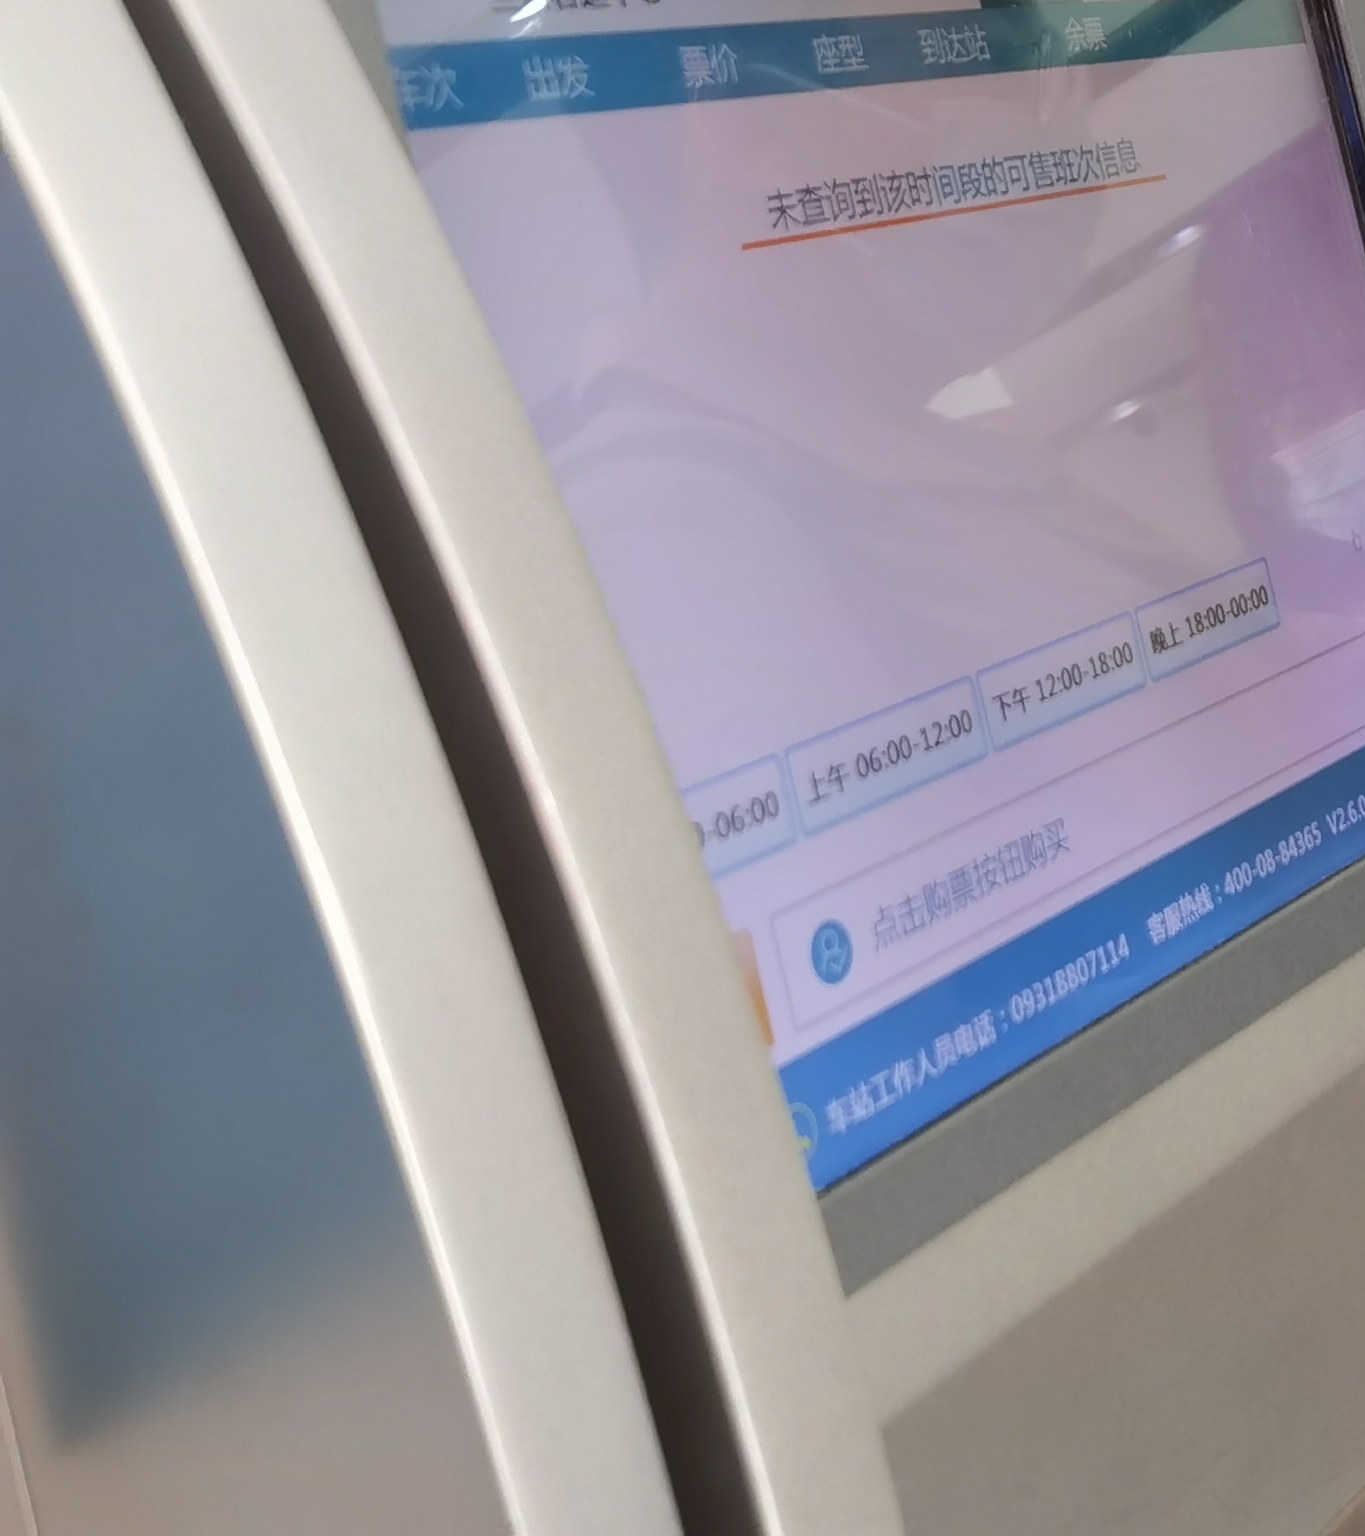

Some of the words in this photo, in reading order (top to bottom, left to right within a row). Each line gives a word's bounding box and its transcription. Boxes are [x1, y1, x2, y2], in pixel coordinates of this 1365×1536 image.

[812, 32, 869, 75] 座型
[917, 24, 992, 65] 到达站
[1065, 16, 1109, 52] 余票
[522, 55, 596, 103] 出发
[678, 42, 739, 88] 票价
[766, 137, 1142, 232] 未查询到该时间段的可售班次信息
[1149, 621, 1184, 655] 晚上
[1185, 584, 1270, 639] 18:00-00:00
[992, 686, 1031, 722] 下午
[1035, 641, 1134, 703] 12:00-18:00
[808, 763, 848, 807] 上午
[855, 708, 974, 780] 06:00-12:00
[873, 817, 1071, 953] 点击购票按钮购买
